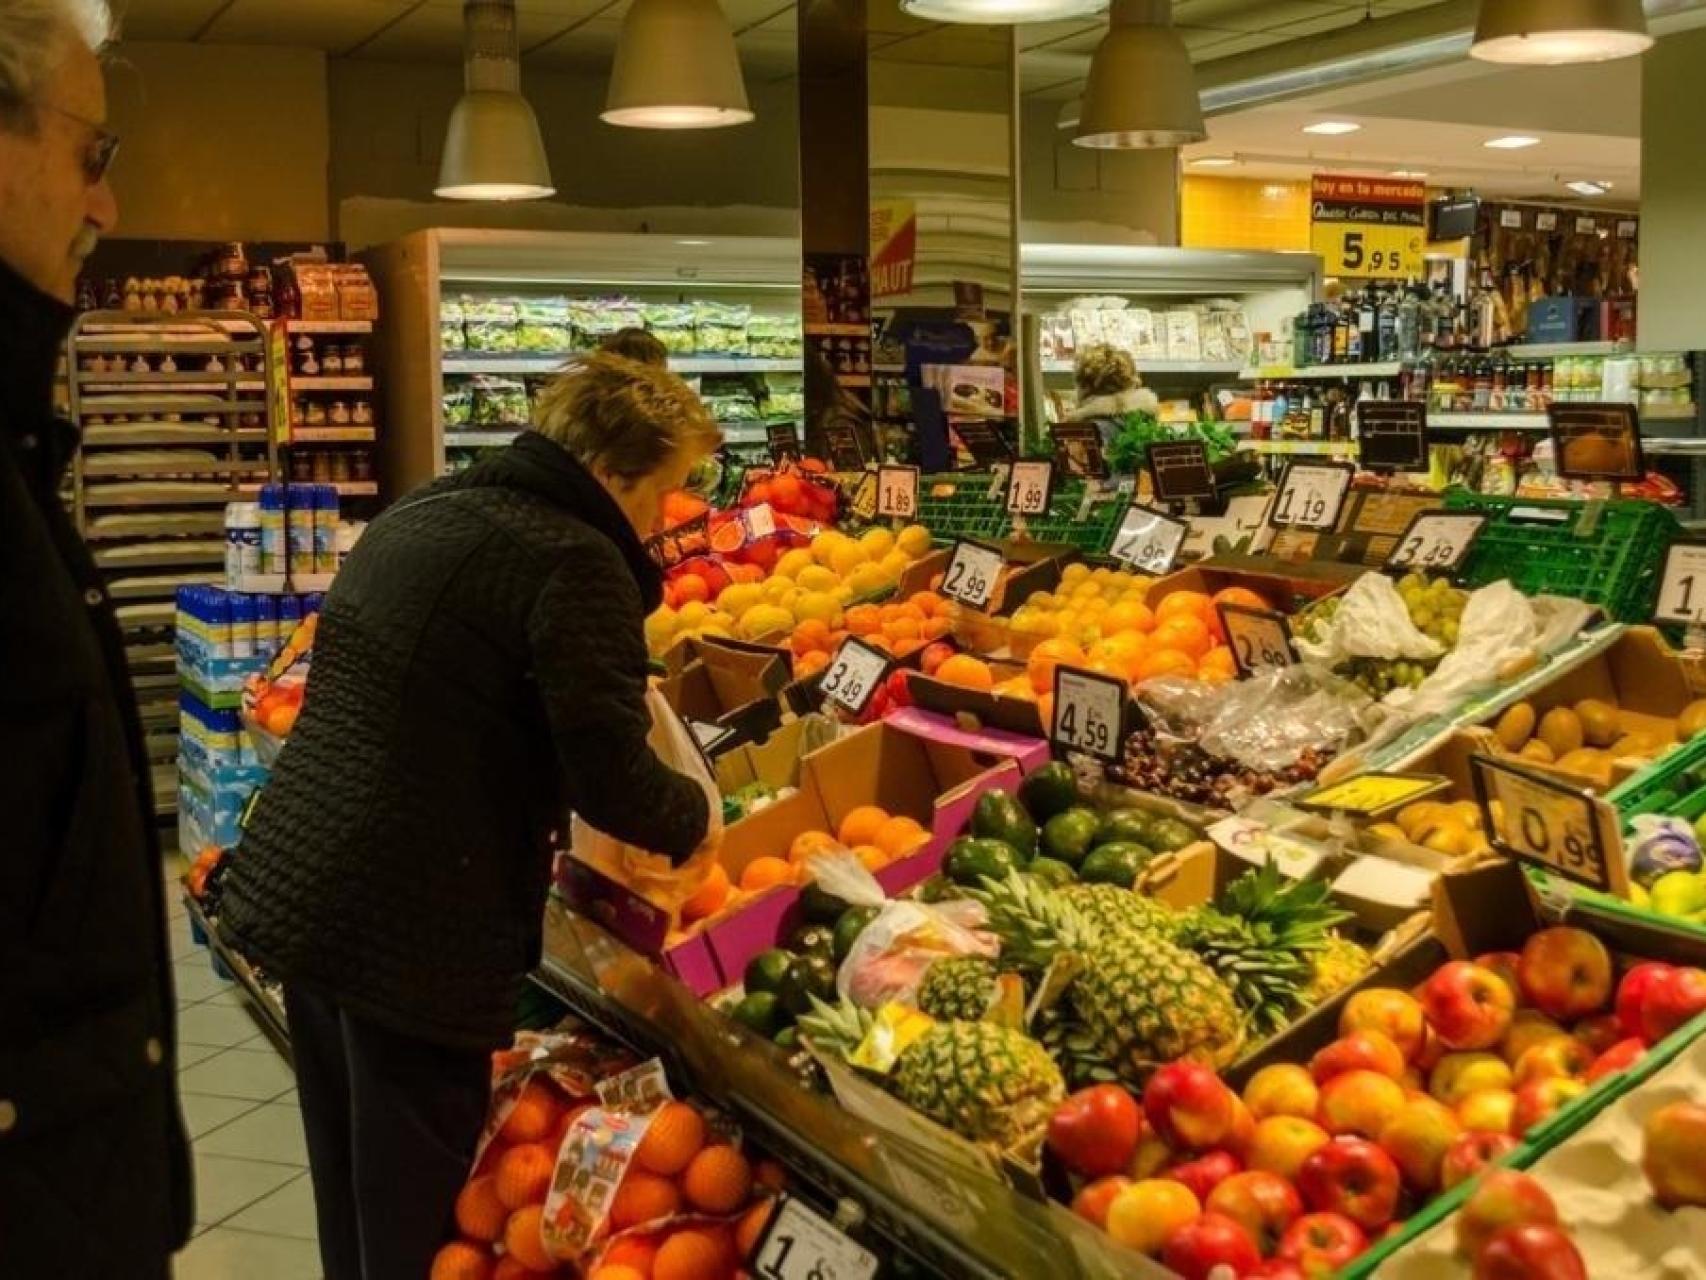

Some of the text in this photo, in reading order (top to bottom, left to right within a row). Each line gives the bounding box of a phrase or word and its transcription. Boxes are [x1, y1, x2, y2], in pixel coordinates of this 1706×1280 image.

[1276, 488, 1326, 522] 1,19
[946, 562, 986, 599] 2,99
[1060, 703, 1108, 751] 4,59
